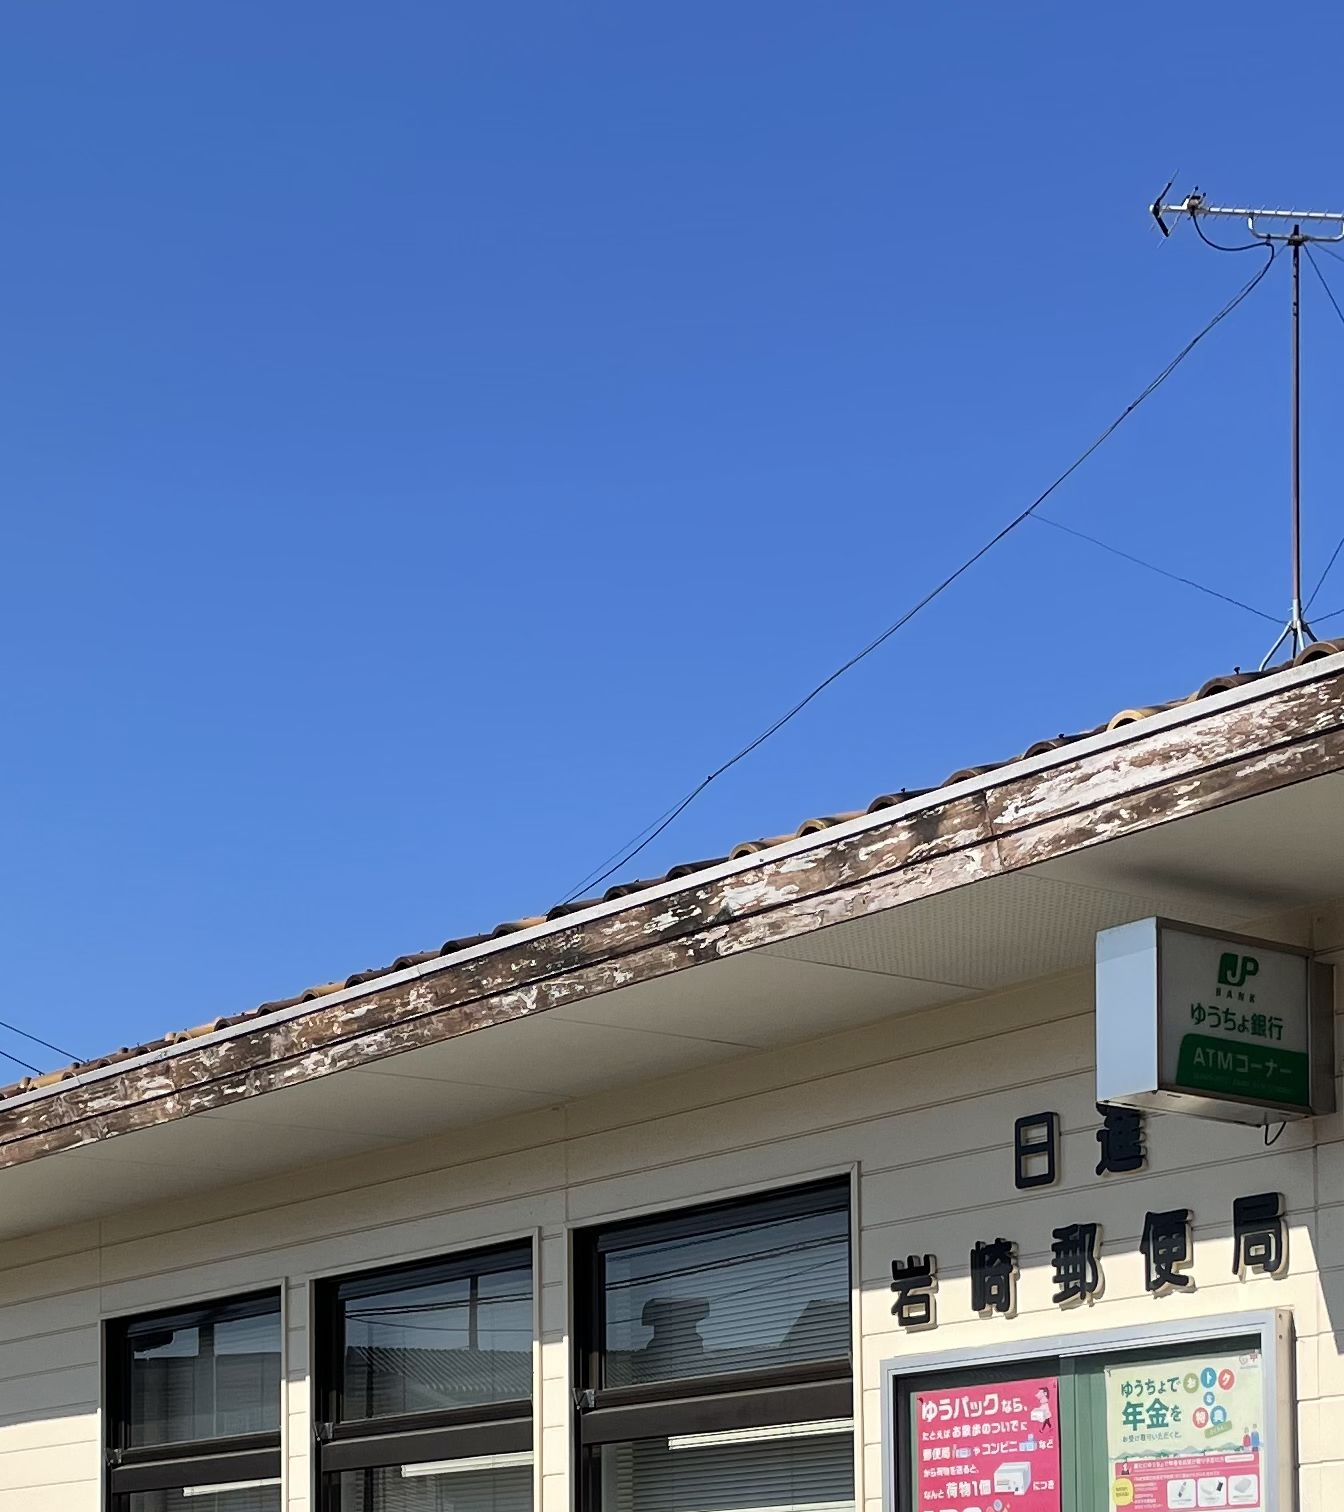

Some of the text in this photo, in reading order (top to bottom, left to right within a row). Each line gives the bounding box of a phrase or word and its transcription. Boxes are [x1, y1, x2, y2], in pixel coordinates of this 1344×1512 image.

[1218, 952, 1260, 987] JP
[1215, 987, 1257, 1003] BANK
[1191, 1002, 1284, 1041] ゆうちょ銀行
[1193, 1047, 1293, 1078] ATMコーナー
[891, 1191, 1283, 1326] 岩崎郵便局
[1121, 1376, 1180, 1398] ゆうちょで
[1122, 1398, 1182, 1431] 年金を
